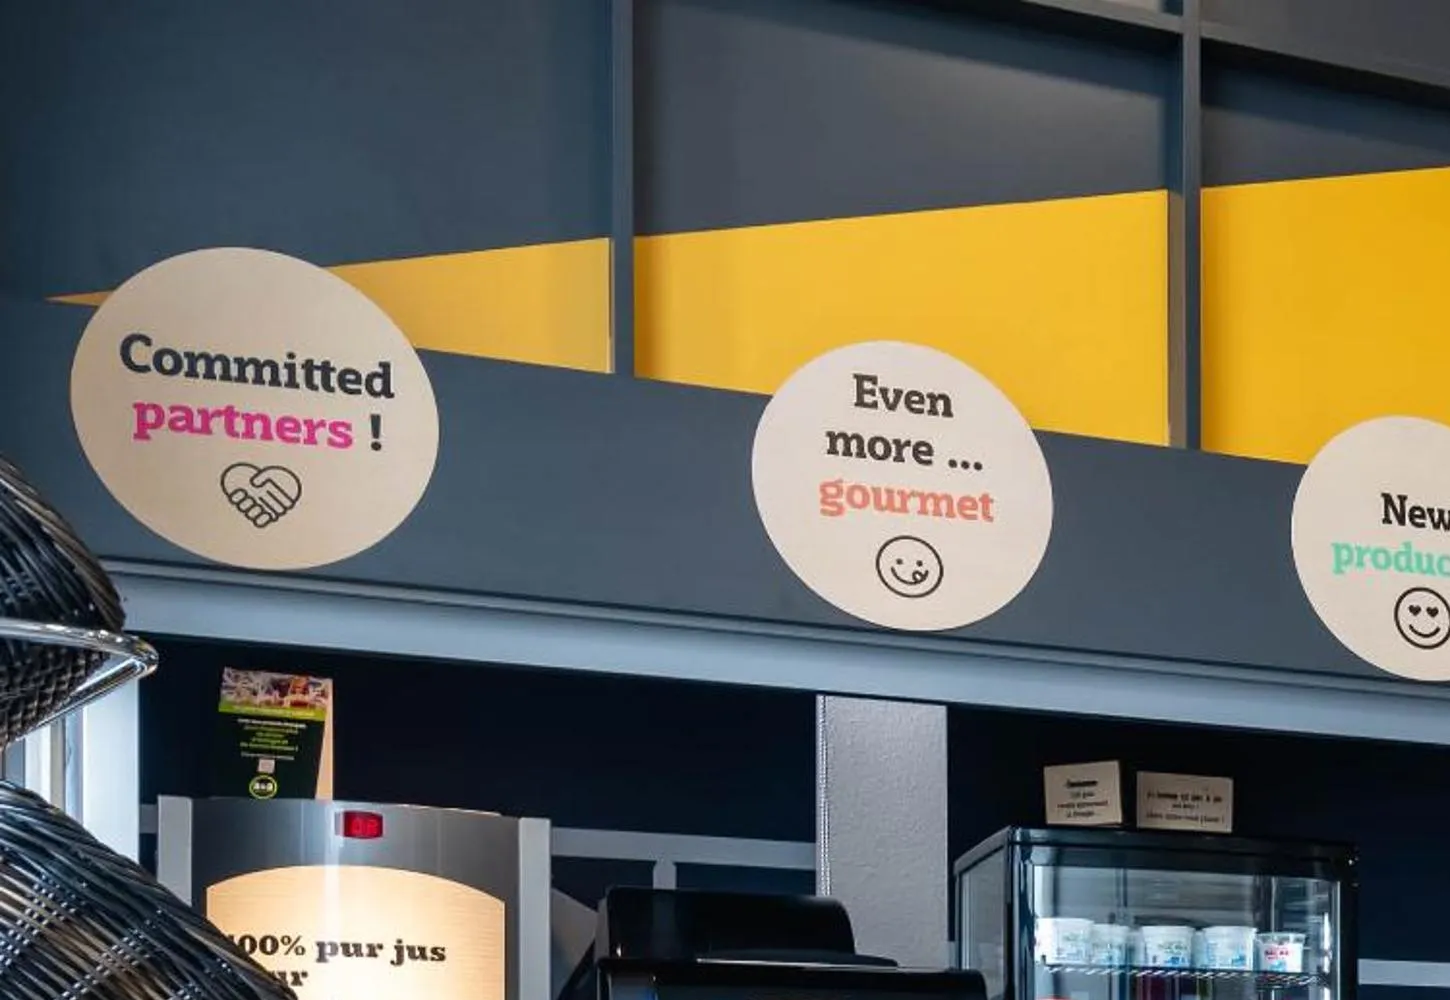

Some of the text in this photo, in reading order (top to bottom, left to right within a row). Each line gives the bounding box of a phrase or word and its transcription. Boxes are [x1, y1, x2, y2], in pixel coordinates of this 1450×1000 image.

[119, 332, 395, 399] Committed
[852, 373, 954, 418] Even
[133, 401, 382, 451] partners !
[825, 430, 935, 466] more
[818, 478, 994, 522] gourmet
[227, 934, 446, 966] 00% pur jus
